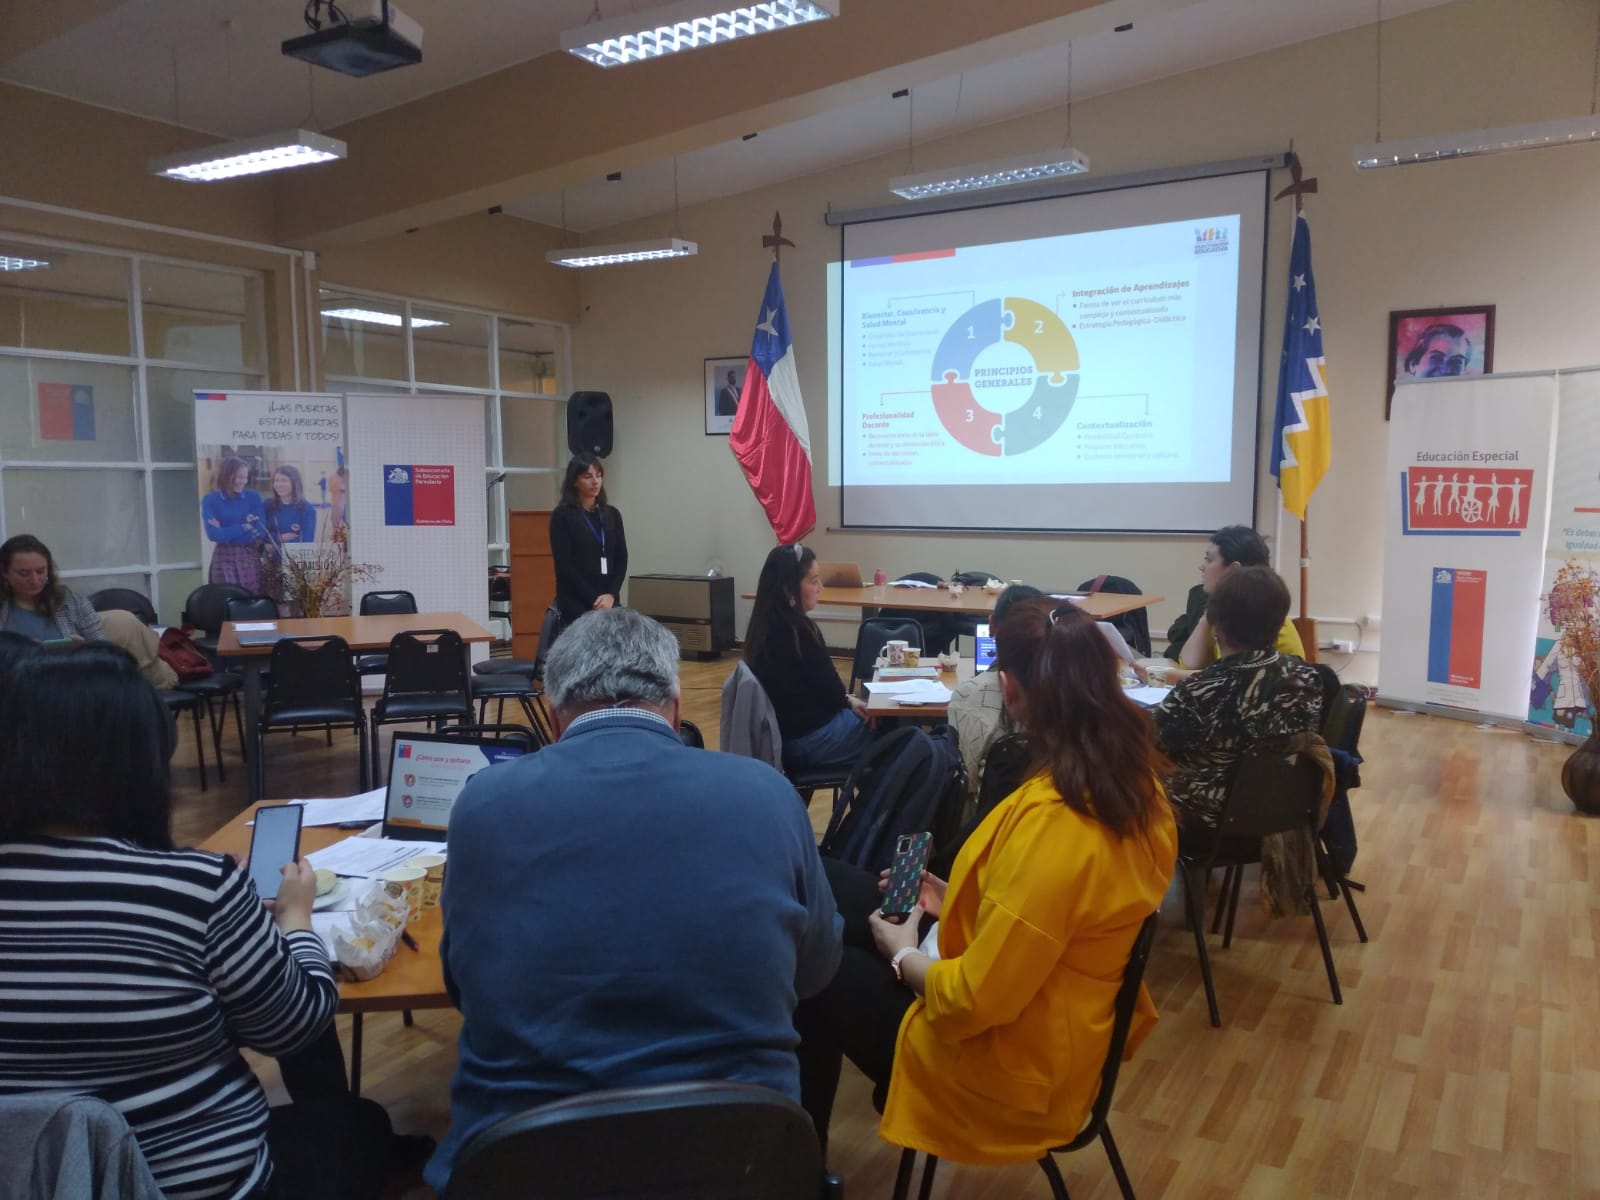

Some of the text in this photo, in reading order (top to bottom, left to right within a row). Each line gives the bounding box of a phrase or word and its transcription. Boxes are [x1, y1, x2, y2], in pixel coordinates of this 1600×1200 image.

[1072, 280, 1190, 298] Integración de Aprendizajes
[967, 325, 976, 339] 1
[1034, 320, 1044, 334] 2
[974, 366, 1033, 377] PRINCIPIOS
[974, 378, 1032, 388] GENERALES
[294, 403, 338, 414] PUERTAS
[1032, 406, 1043, 420] 4
[965, 409, 974, 422] 3
[294, 418, 339, 428] ABIERTAS
[1076, 420, 1153, 430] Contextualización
[232, 430, 257, 440] PARA
[260, 431, 293, 440] TODAS
[295, 431, 303, 440] Y
[1416, 450, 1519, 463] Educación Especial
